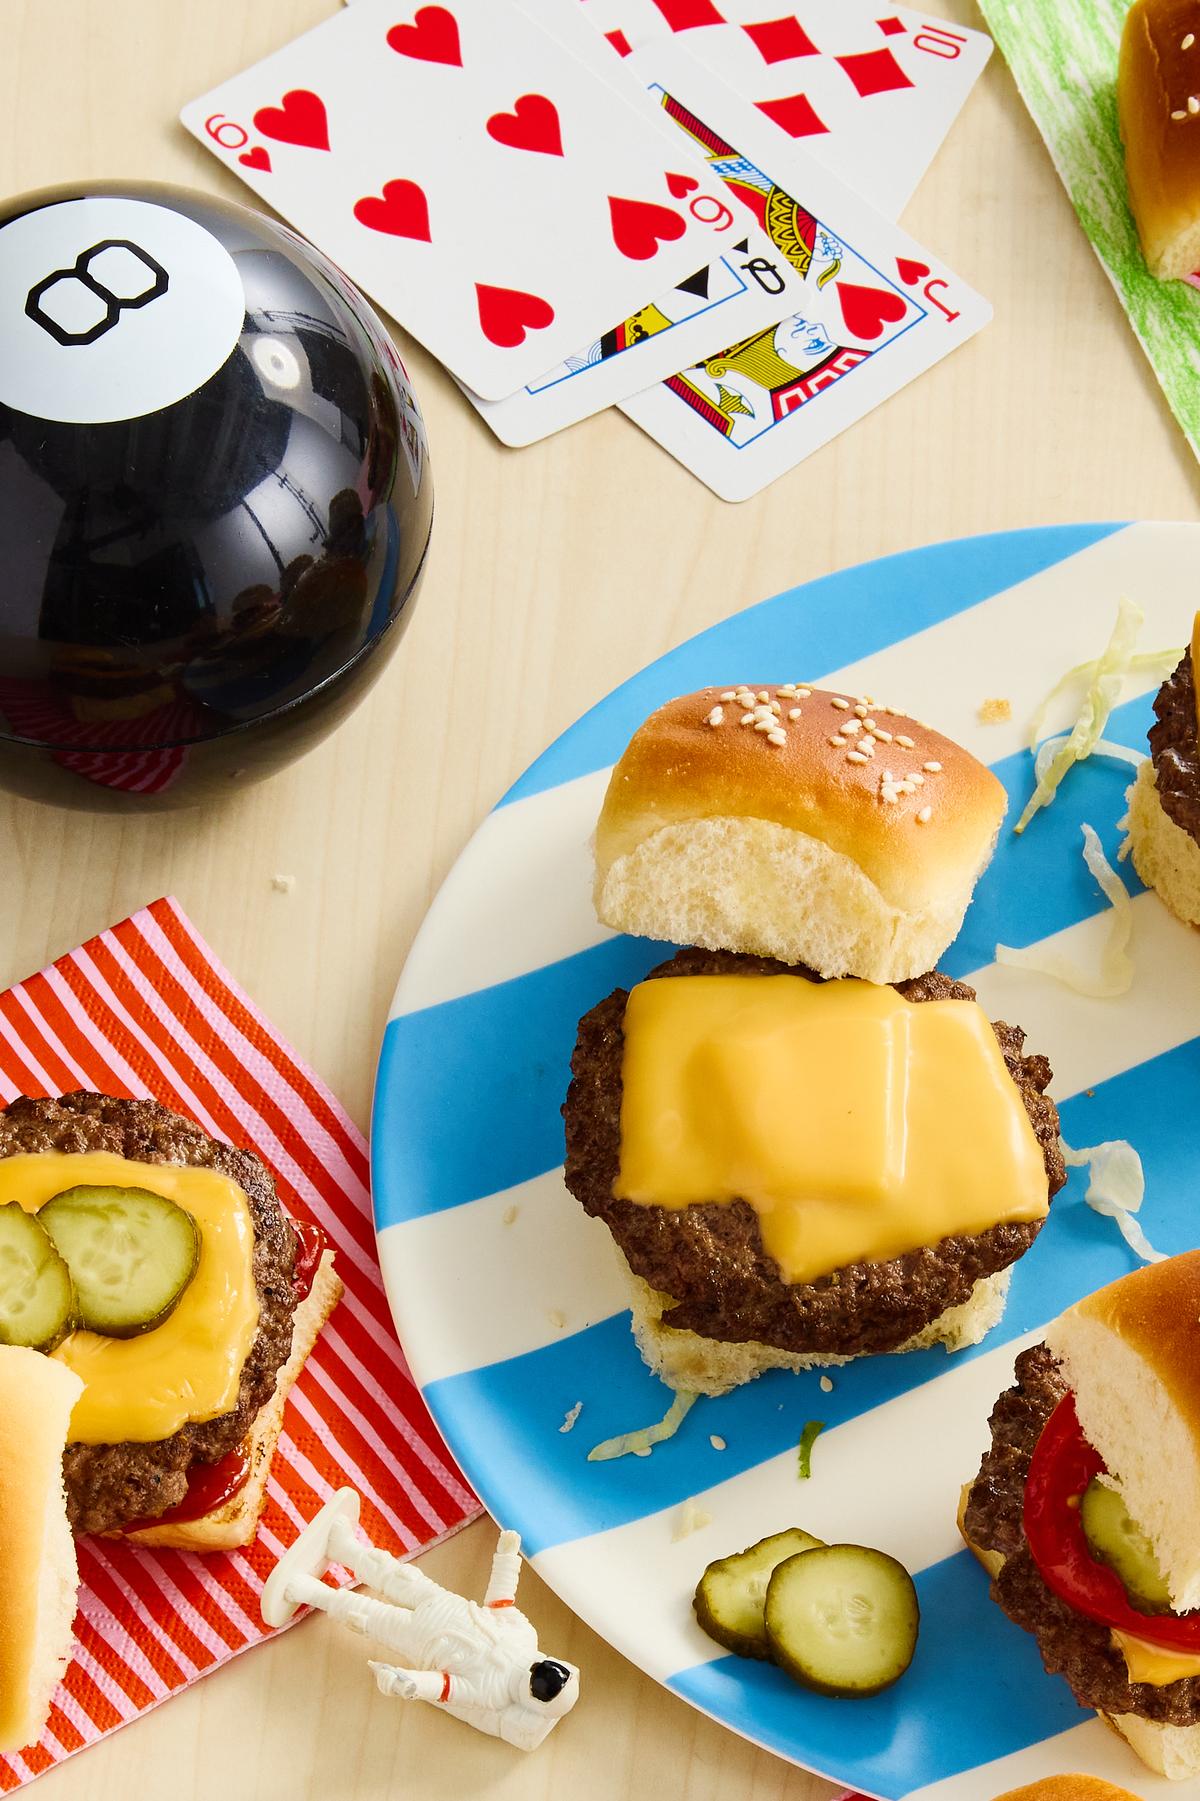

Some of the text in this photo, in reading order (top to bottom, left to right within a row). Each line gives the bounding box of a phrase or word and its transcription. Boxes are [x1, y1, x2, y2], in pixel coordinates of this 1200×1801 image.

[914, 25, 967, 59] 10
[205, 114, 248, 149] 6
[25, 239, 169, 346] 8
[740, 257, 786, 295] Q
[923, 279, 961, 323] J
